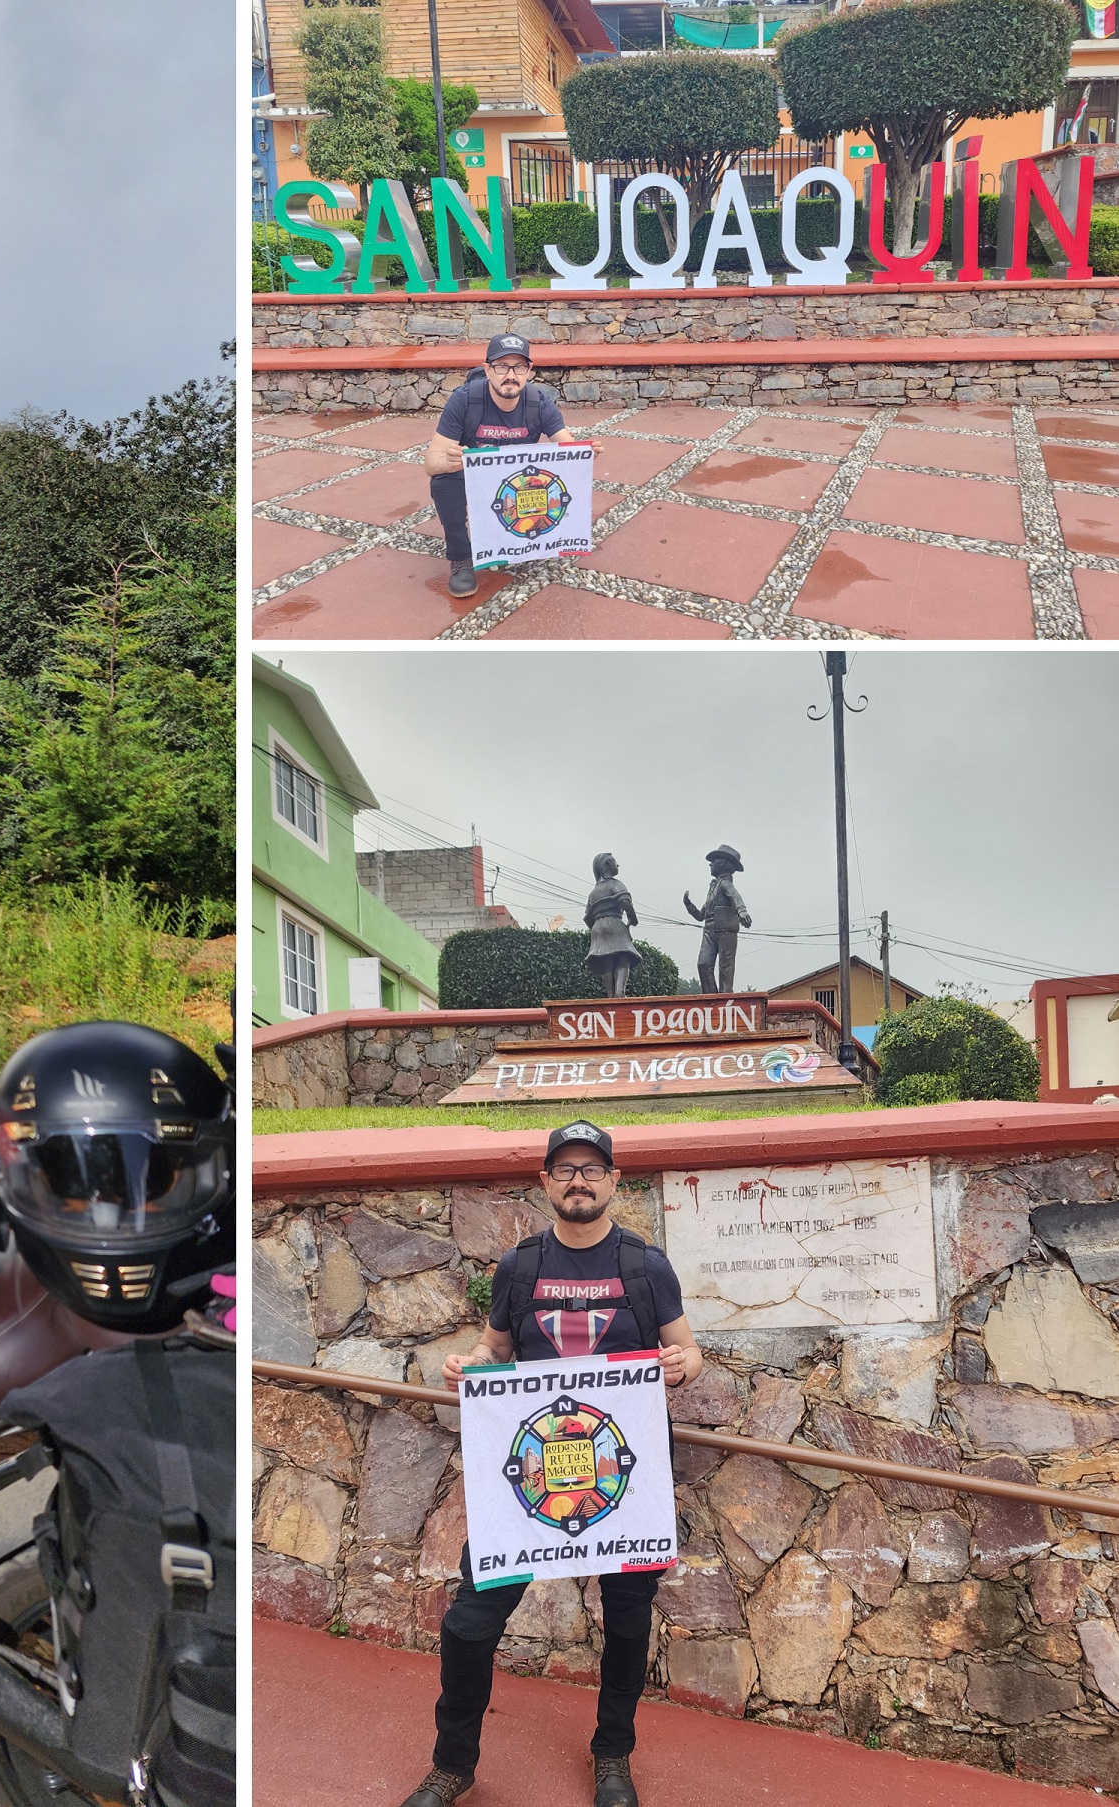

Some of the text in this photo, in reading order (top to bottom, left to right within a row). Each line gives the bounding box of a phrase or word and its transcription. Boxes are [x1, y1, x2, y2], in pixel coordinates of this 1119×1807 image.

[273, 135, 1096, 295] SAN JOAQUÍN
[482, 428, 522, 440] TRIUMPH
[465, 449, 593, 468] MOTOTURISMO
[476, 537, 589, 560] EN ACCIÓN MÉXICO
[711, 1181, 882, 1202] ESTA OBRA FUE CONSTRUIDA POR
[778, 1257, 795, 1269] CON
[839, 1254, 857, 1267] DEL
[859, 1253, 899, 1266] ESTADO
[542, 1284, 610, 1299] TRIUMPH
[821, 1288, 881, 1301] SEPTIEMBRE
[883, 1288, 897, 1299] DE
[464, 1366, 661, 1398] MOTOTURISMO
[558, 1401, 572, 1412] N
[620, 1455, 632, 1465] E
[506, 1465, 520, 1475] O
[567, 1520, 580, 1531] S
[479, 1535, 672, 1572] EN ACCIÓN MÉXICO
[628, 1555, 672, 1566] RRM 4.0
